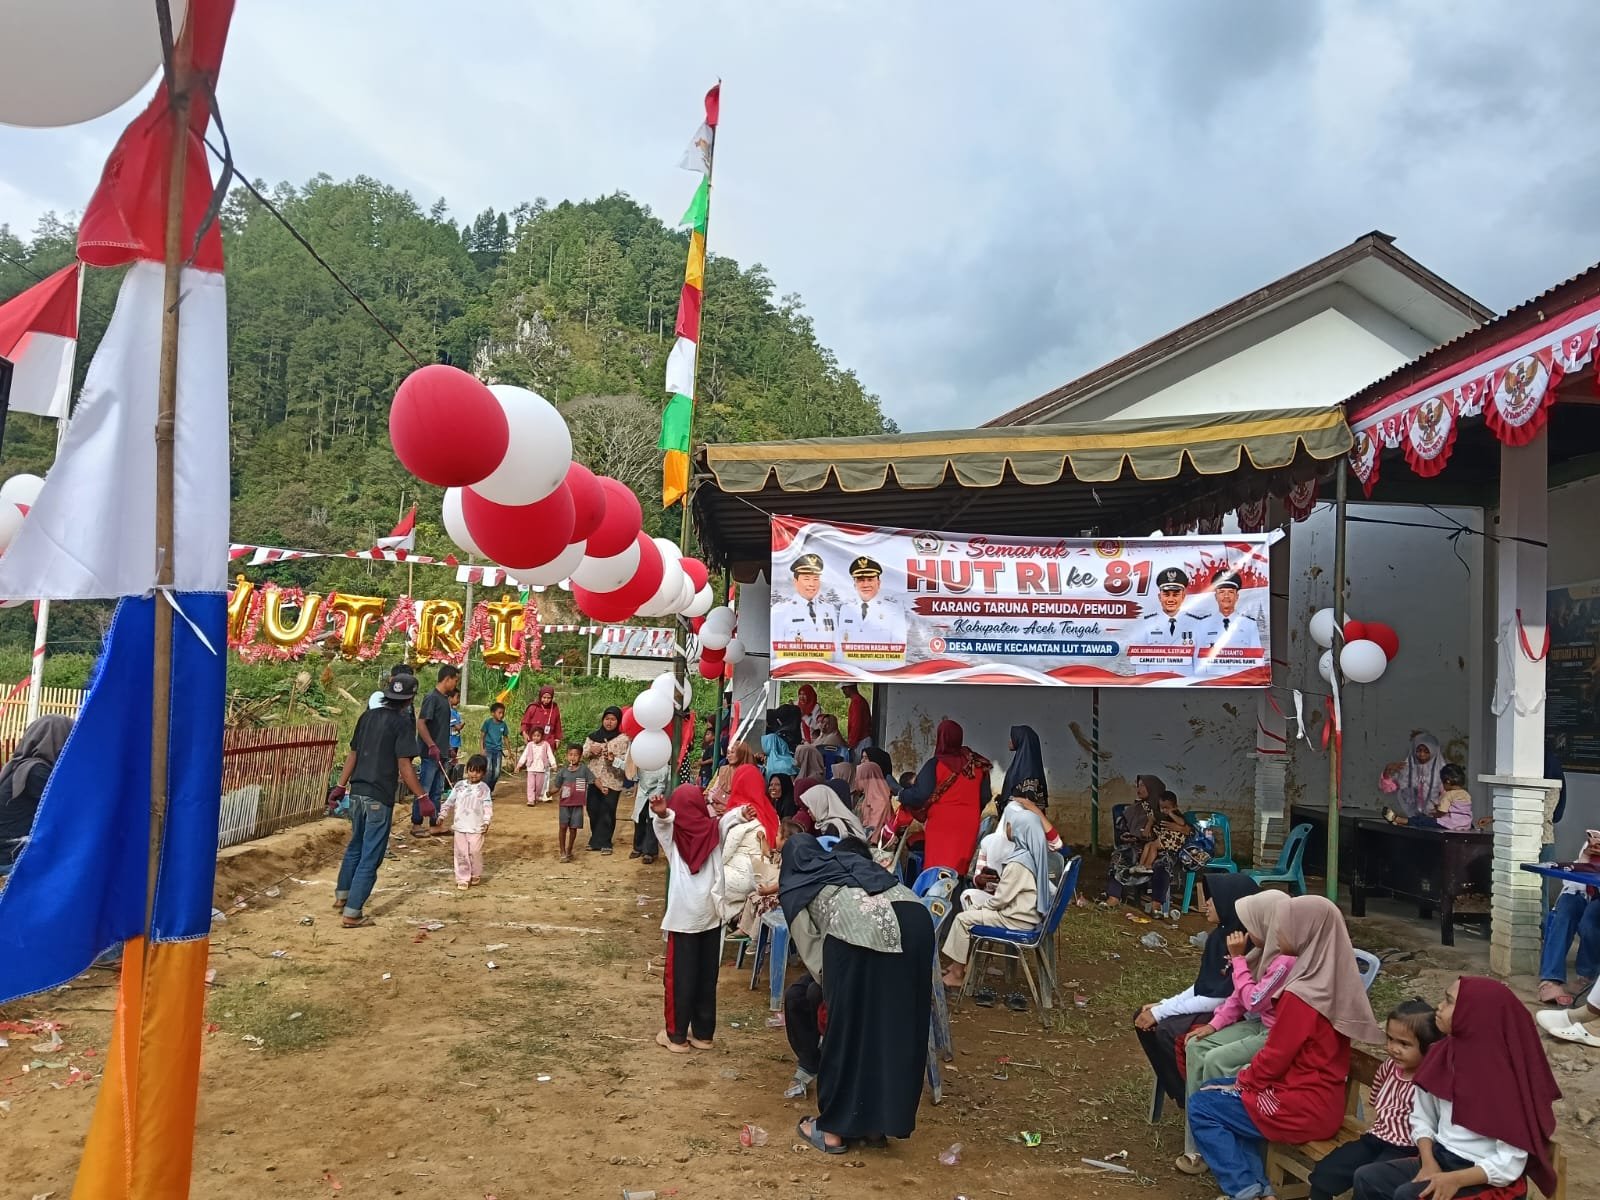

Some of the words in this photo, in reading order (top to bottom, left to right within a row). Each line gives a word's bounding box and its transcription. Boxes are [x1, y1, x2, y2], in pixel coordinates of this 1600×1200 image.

[966, 537, 1070, 559] Semarak
[906, 559, 1005, 595] HUT
[1016, 562, 1062, 595] RI
[1066, 566, 1098, 588] ke
[1104, 560, 1153, 596] 81
[932, 601, 981, 613] KARANG
[984, 602, 1029, 613] TARUNA
[1032, 603, 1127, 615] PEMUDA/PEMUDI
[416, 599, 525, 666] RI
[954, 618, 1019, 636] Kabupaten
[1023, 620, 1056, 634] Aceh
[1060, 620, 1100, 637] Tengah
[949, 642, 973, 651] DESA
[975, 643, 1002, 652] RAWE
[1004, 643, 1060, 653] KECAMATAN
[1062, 644, 1079, 653] LUT
[1080, 645, 1113, 654] TAWAR
